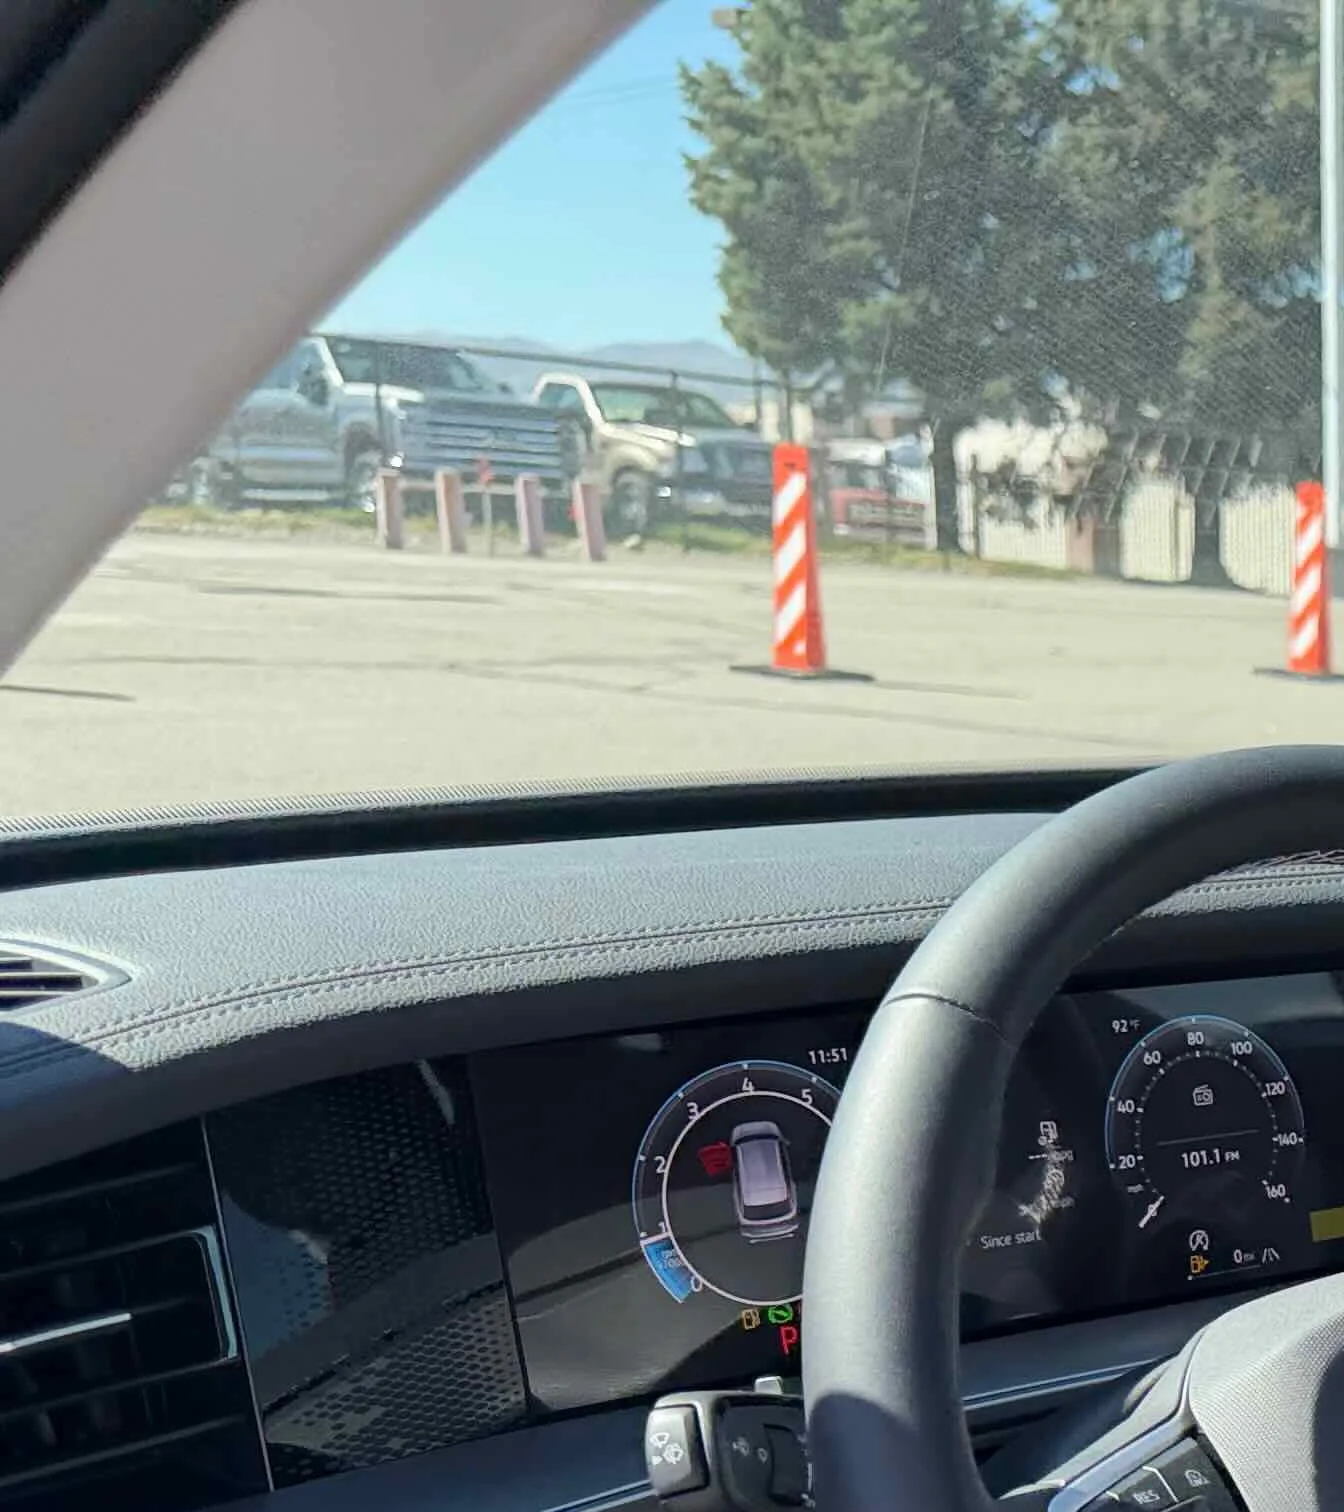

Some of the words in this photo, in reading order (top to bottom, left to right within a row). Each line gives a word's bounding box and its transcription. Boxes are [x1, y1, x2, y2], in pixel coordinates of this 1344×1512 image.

[1112, 1020, 1128, 1033] 92
[1187, 1032, 1204, 1046] 80
[1231, 1041, 1252, 1056] 100
[808, 1048, 848, 1065] 11:51
[1143, 1051, 1161, 1065] 60
[742, 1077, 755, 1092] 4
[1265, 1081, 1285, 1096] 120
[801, 1088, 813, 1105] 5
[686, 1102, 700, 1120] 3
[1117, 1100, 1135, 1113] 40
[1277, 1132, 1298, 1146] 140
[654, 1156, 666, 1173] 2
[1118, 1154, 1136, 1168] 20
[1181, 1148, 1221, 1168] 101.1
[1225, 1151, 1240, 1162] FM
[1265, 1183, 1286, 1198] 160
[981, 1234, 1012, 1249] Since
[1015, 1229, 1041, 1244] start
[690, 1274, 703, 1292] 0
[780, 1326, 798, 1355] P
[1132, 1487, 1160, 1504] RES
